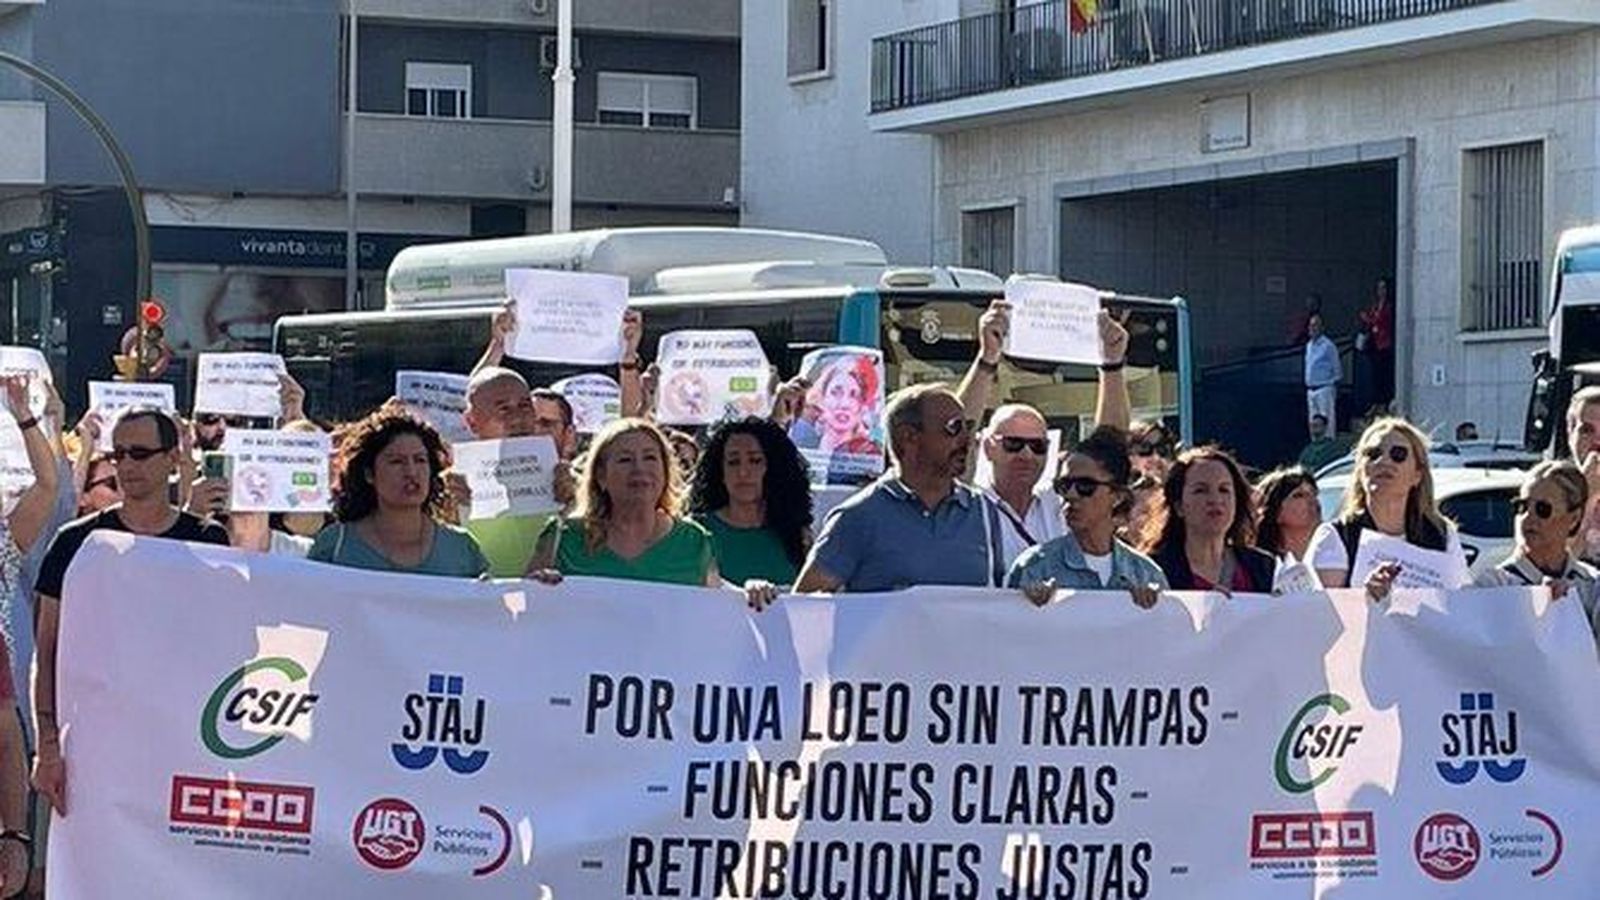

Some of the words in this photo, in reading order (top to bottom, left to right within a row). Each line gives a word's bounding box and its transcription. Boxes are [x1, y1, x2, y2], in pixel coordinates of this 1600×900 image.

[224, 686, 321, 727] CSIF
[402, 692, 486, 745] STAJ
[585, 673, 674, 740] POR
[692, 683, 782, 744] UNA
[801, 681, 911, 744] LOEO
[927, 682, 1000, 745] SIN
[1017, 685, 1210, 747] TRAMPAS
[1292, 724, 1364, 761] CSIF
[1441, 710, 1518, 757] STAJ
[180, 785, 306, 825] CCOO
[683, 760, 934, 824] FUNCIONES
[951, 763, 1118, 825] CLARAS
[362, 808, 417, 839] UGT
[435, 825, 493, 840] Servicios
[1260, 820, 1369, 850] CCOO
[1422, 824, 1472, 851] UGT
[1489, 832, 1545, 845] Servicios
[626, 837, 981, 900] RETRIBUCIONES
[996, 842, 1152, 900] JUSTAS
